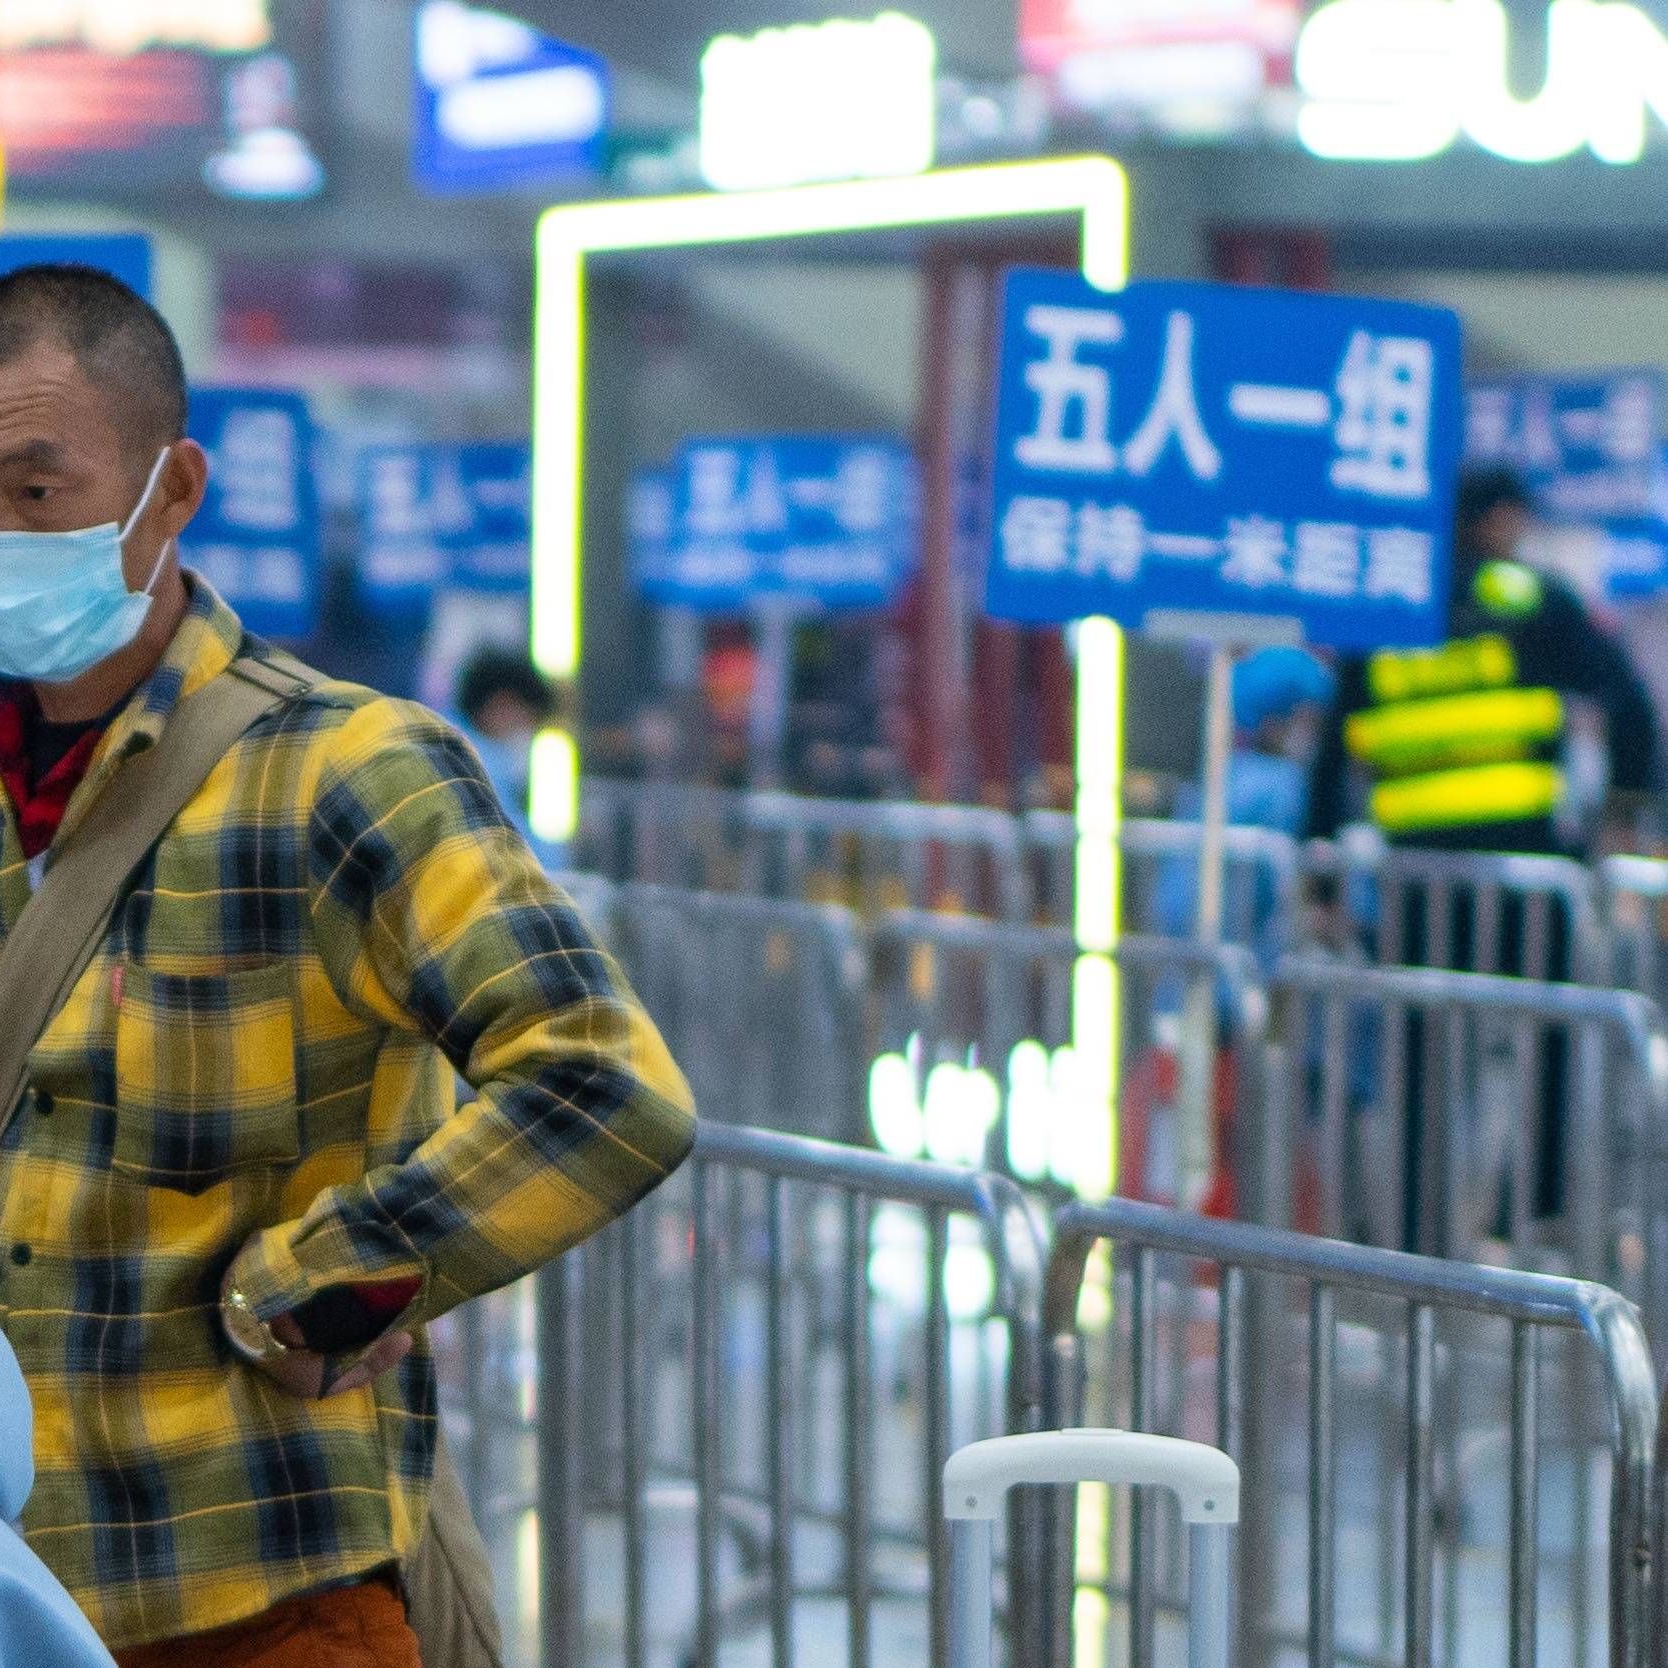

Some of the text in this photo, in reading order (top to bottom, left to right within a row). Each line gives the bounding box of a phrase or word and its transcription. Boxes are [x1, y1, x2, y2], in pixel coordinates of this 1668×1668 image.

[1015, 303, 1434, 500] 五人一组
[1000, 496, 1434, 603] 保持一米距离
